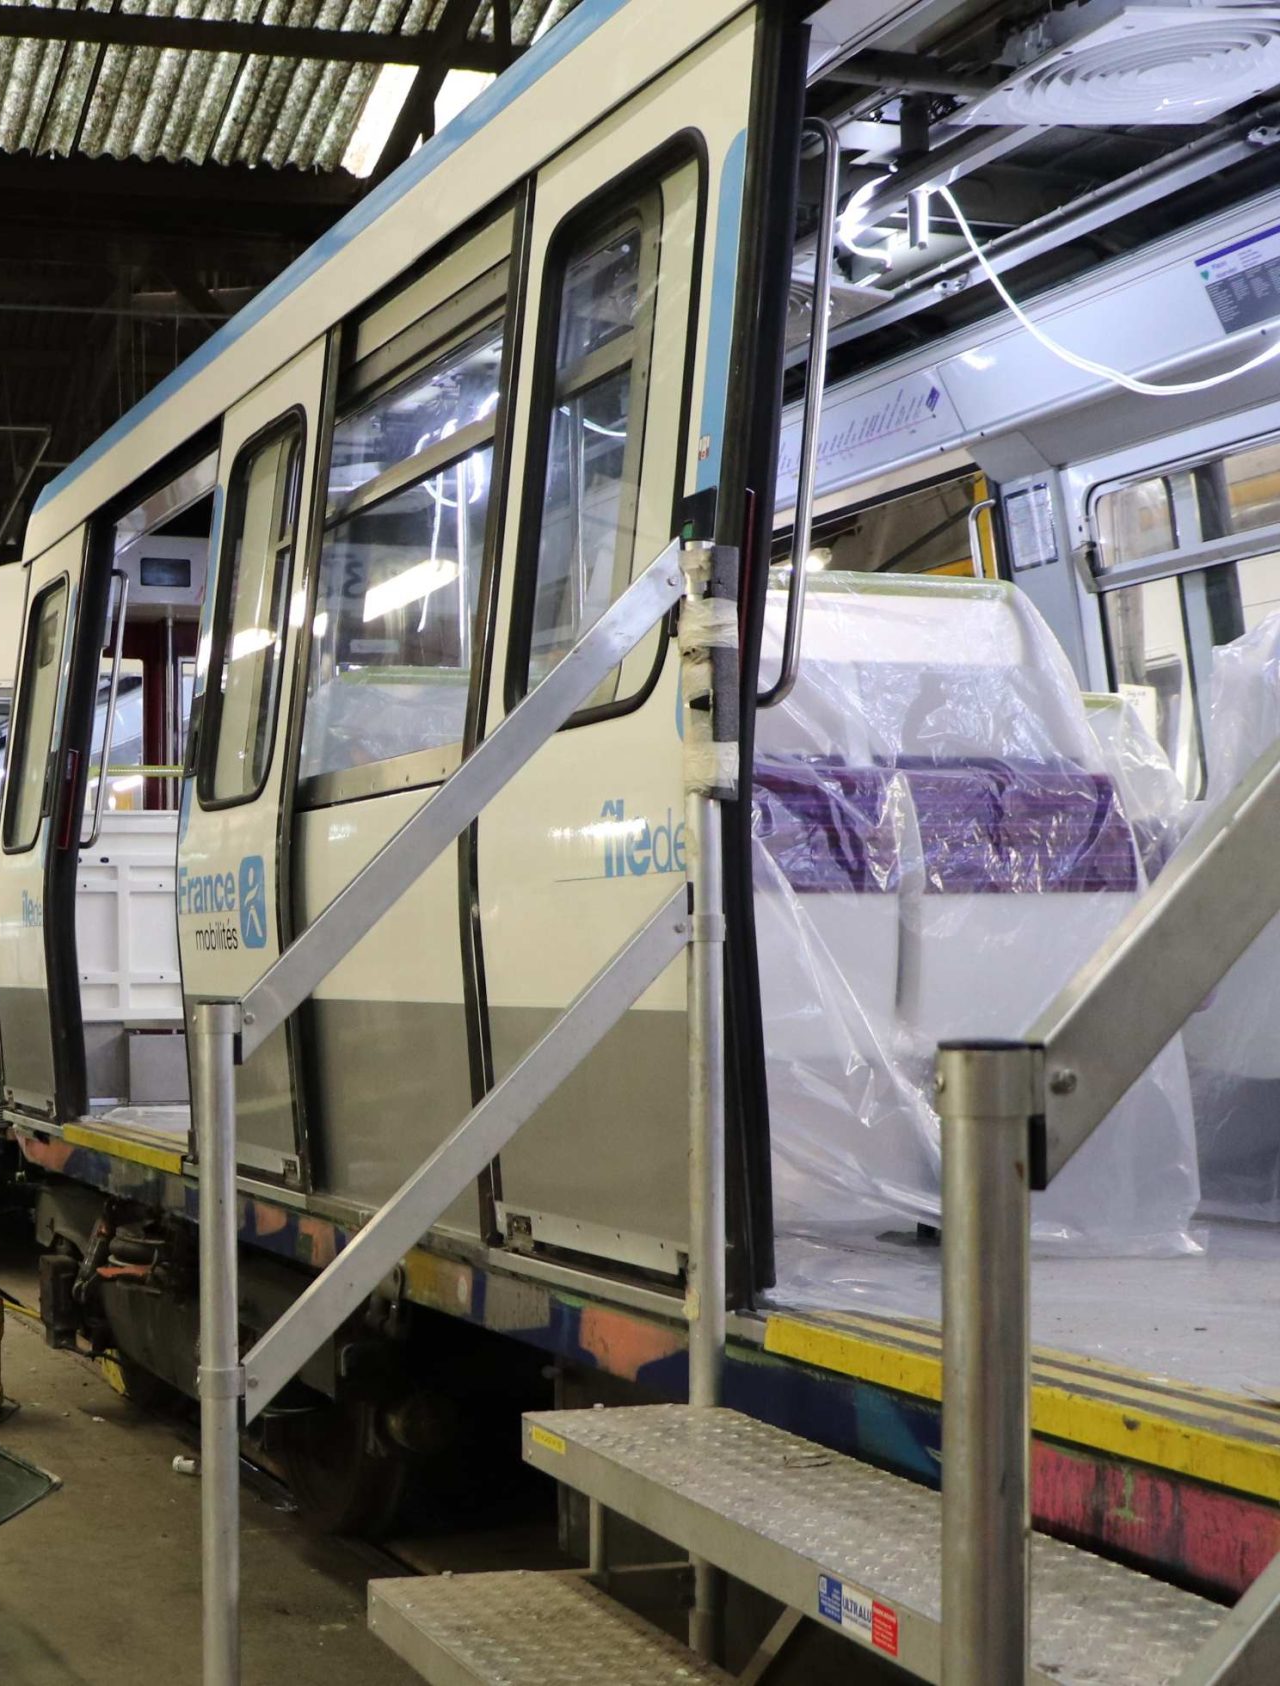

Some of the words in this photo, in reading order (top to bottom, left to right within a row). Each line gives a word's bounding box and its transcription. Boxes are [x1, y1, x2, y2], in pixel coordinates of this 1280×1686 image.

[178, 867, 236, 914] France
[195, 919, 239, 950] mobilités
[842, 1595, 872, 1623] ULTRALU
